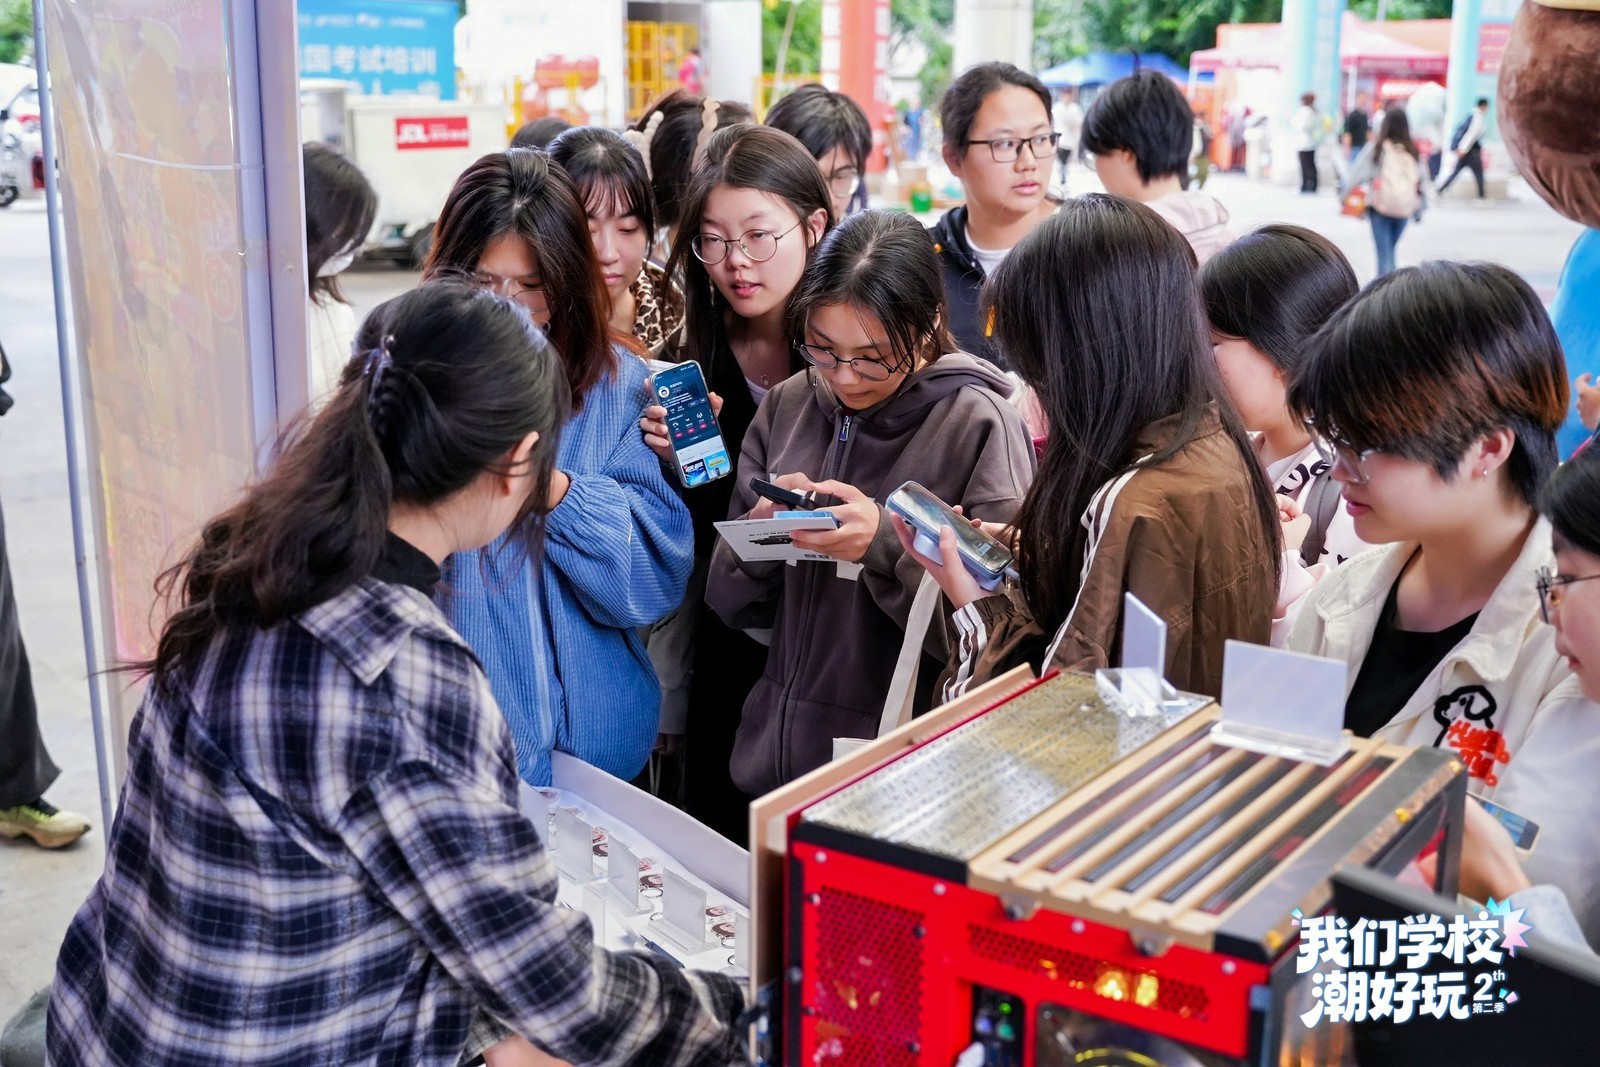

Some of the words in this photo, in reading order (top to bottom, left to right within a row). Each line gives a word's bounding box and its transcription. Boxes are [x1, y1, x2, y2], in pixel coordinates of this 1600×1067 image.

[299, 45, 437, 74] 国考试培训
[397, 123, 429, 144] JDL
